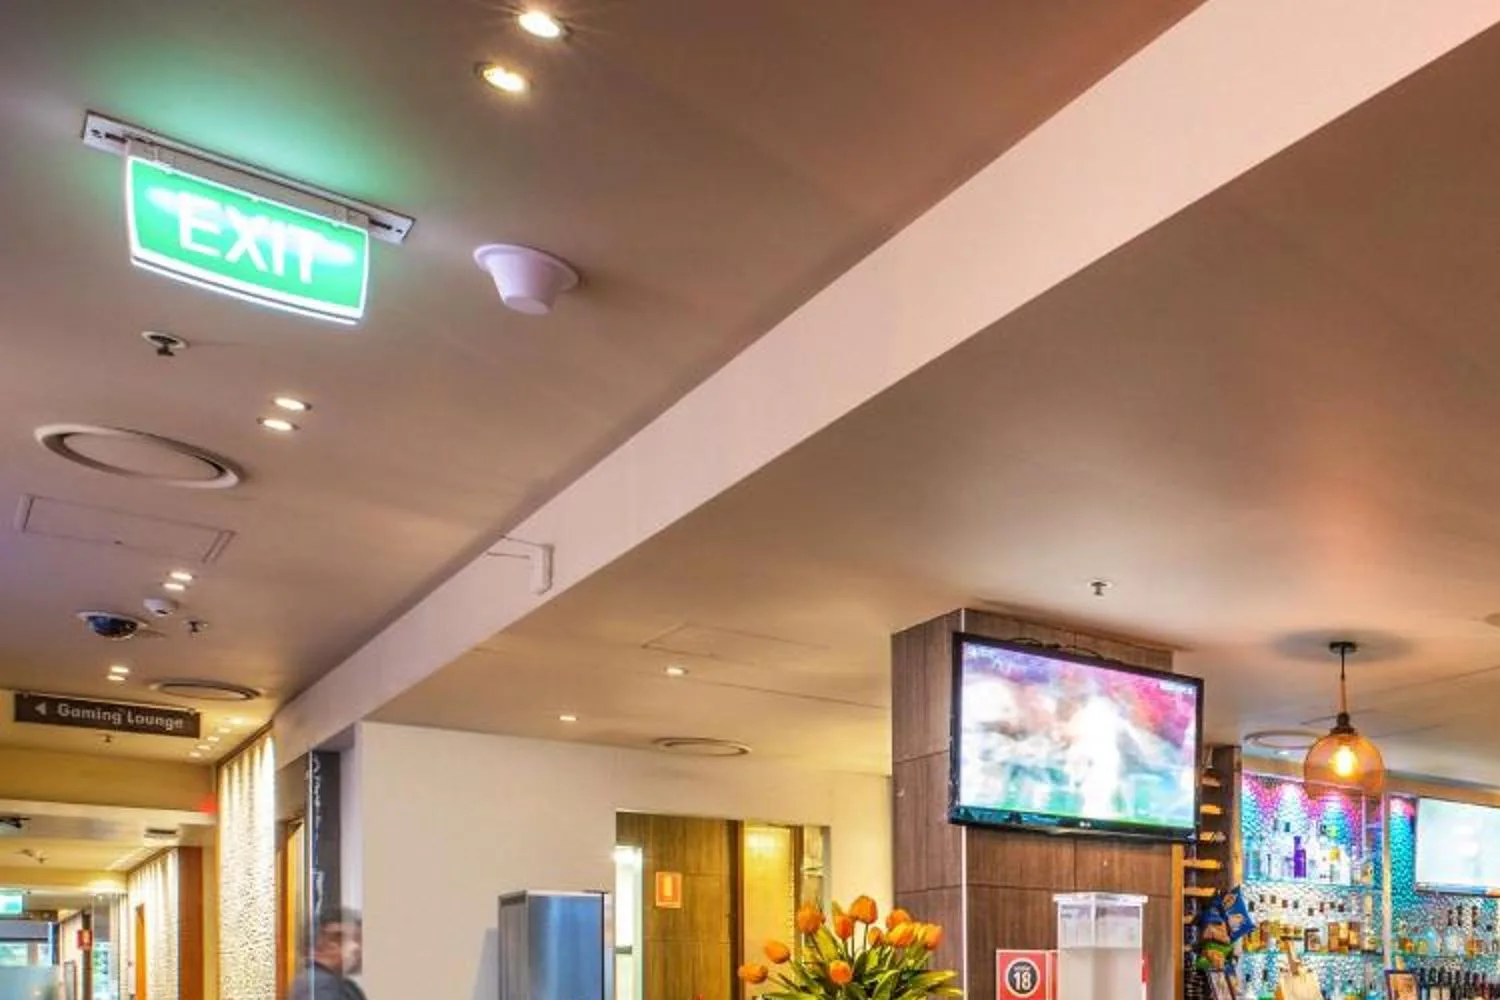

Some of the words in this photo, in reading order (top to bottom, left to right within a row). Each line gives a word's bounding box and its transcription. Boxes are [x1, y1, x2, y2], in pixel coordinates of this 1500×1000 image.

[177, 192, 324, 284] EXIT
[57, 703, 122, 725] Gaming
[127, 710, 183, 731] Lounge
[1013, 970, 1032, 991] 18
